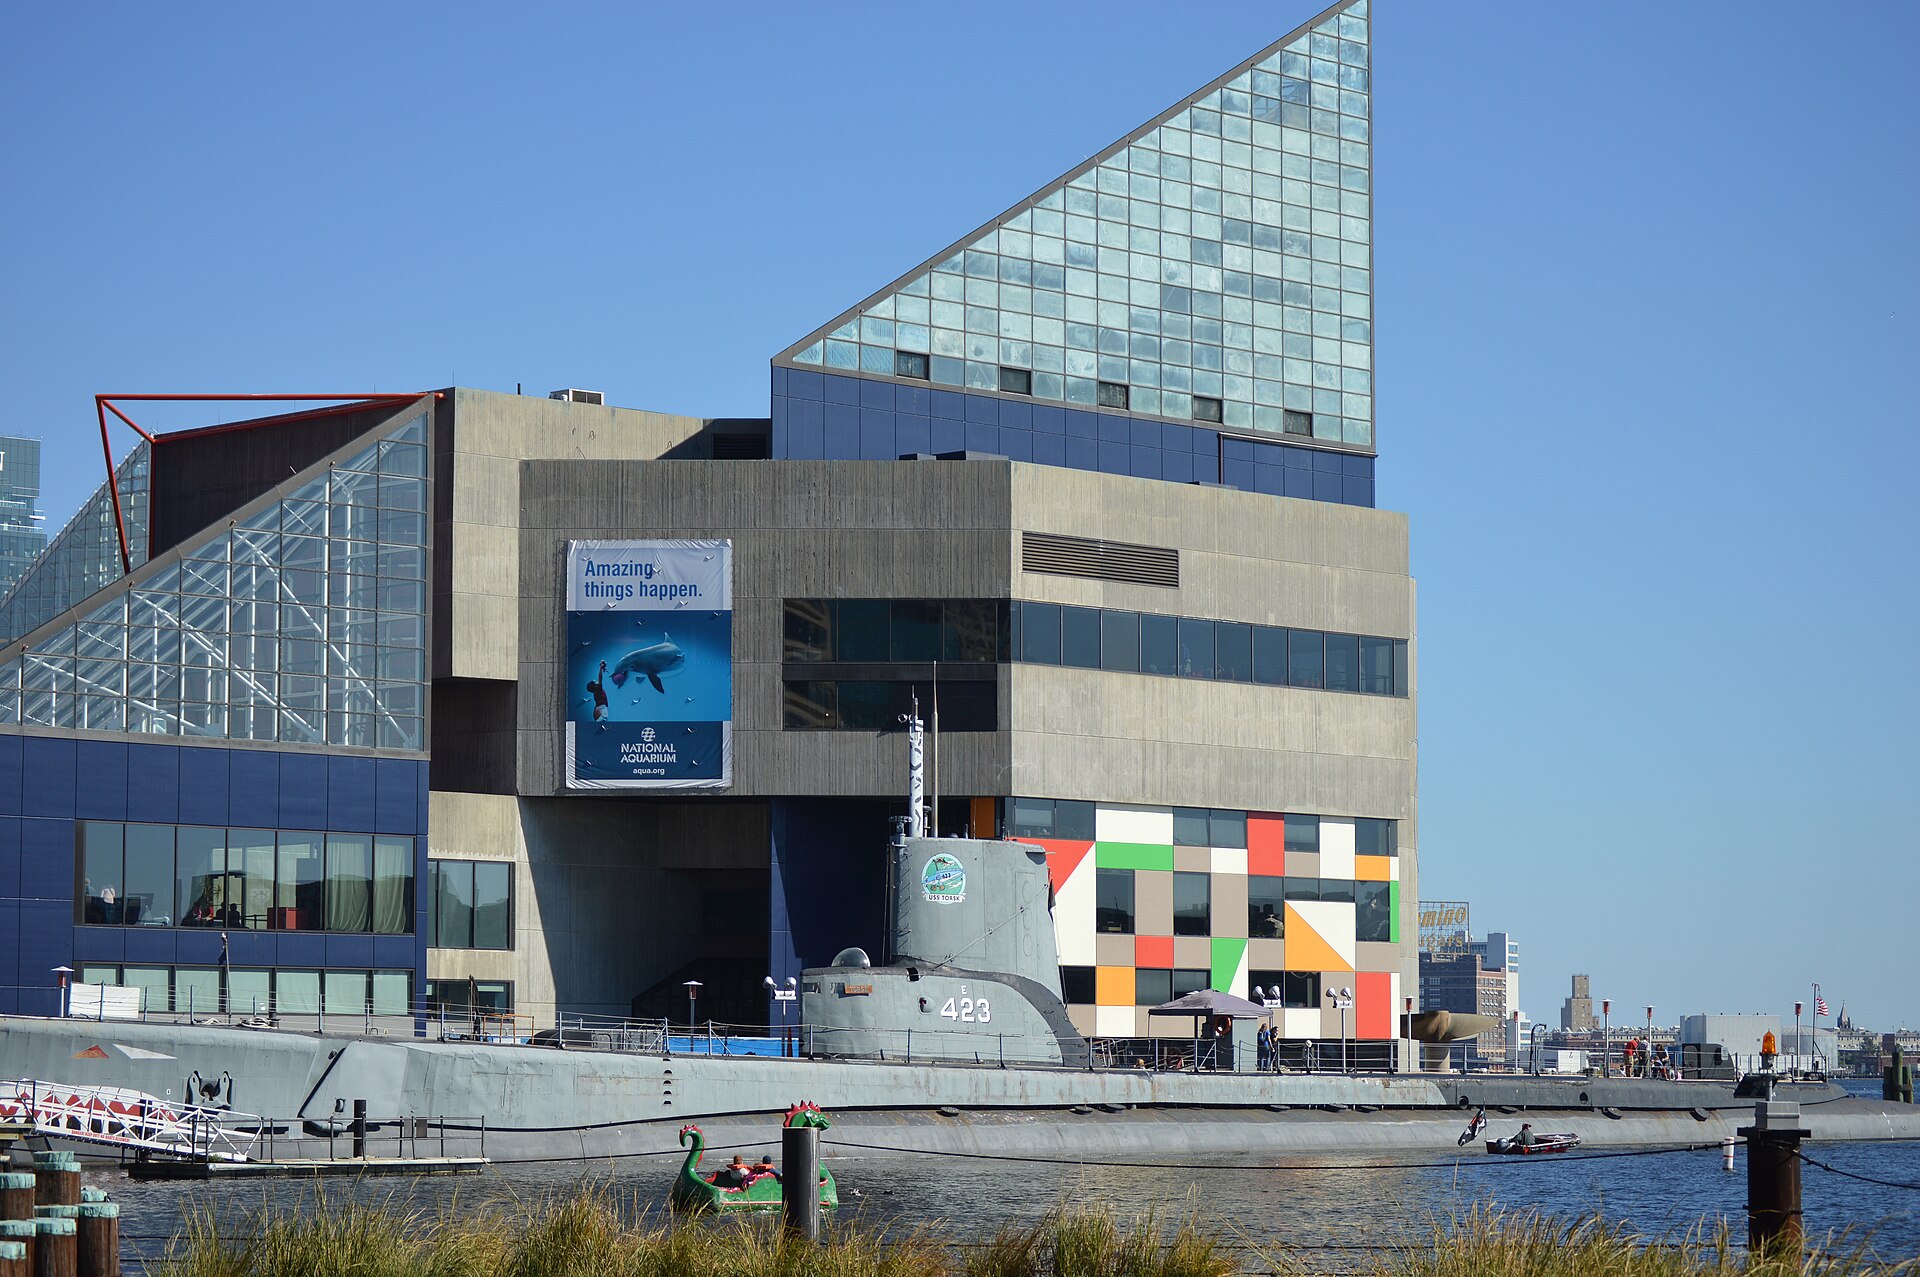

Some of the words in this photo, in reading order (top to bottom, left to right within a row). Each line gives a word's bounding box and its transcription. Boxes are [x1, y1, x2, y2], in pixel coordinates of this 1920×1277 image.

[585, 560, 653, 579] Amazing
[584, 581, 633, 601] things
[639, 581, 702, 601] happen.
[621, 743, 676, 753] NATIONAL
[620, 753, 677, 763] AQUARIUM
[1418, 904, 1467, 927] mino
[960, 985, 967, 995] E
[940, 997, 991, 1023] 423
